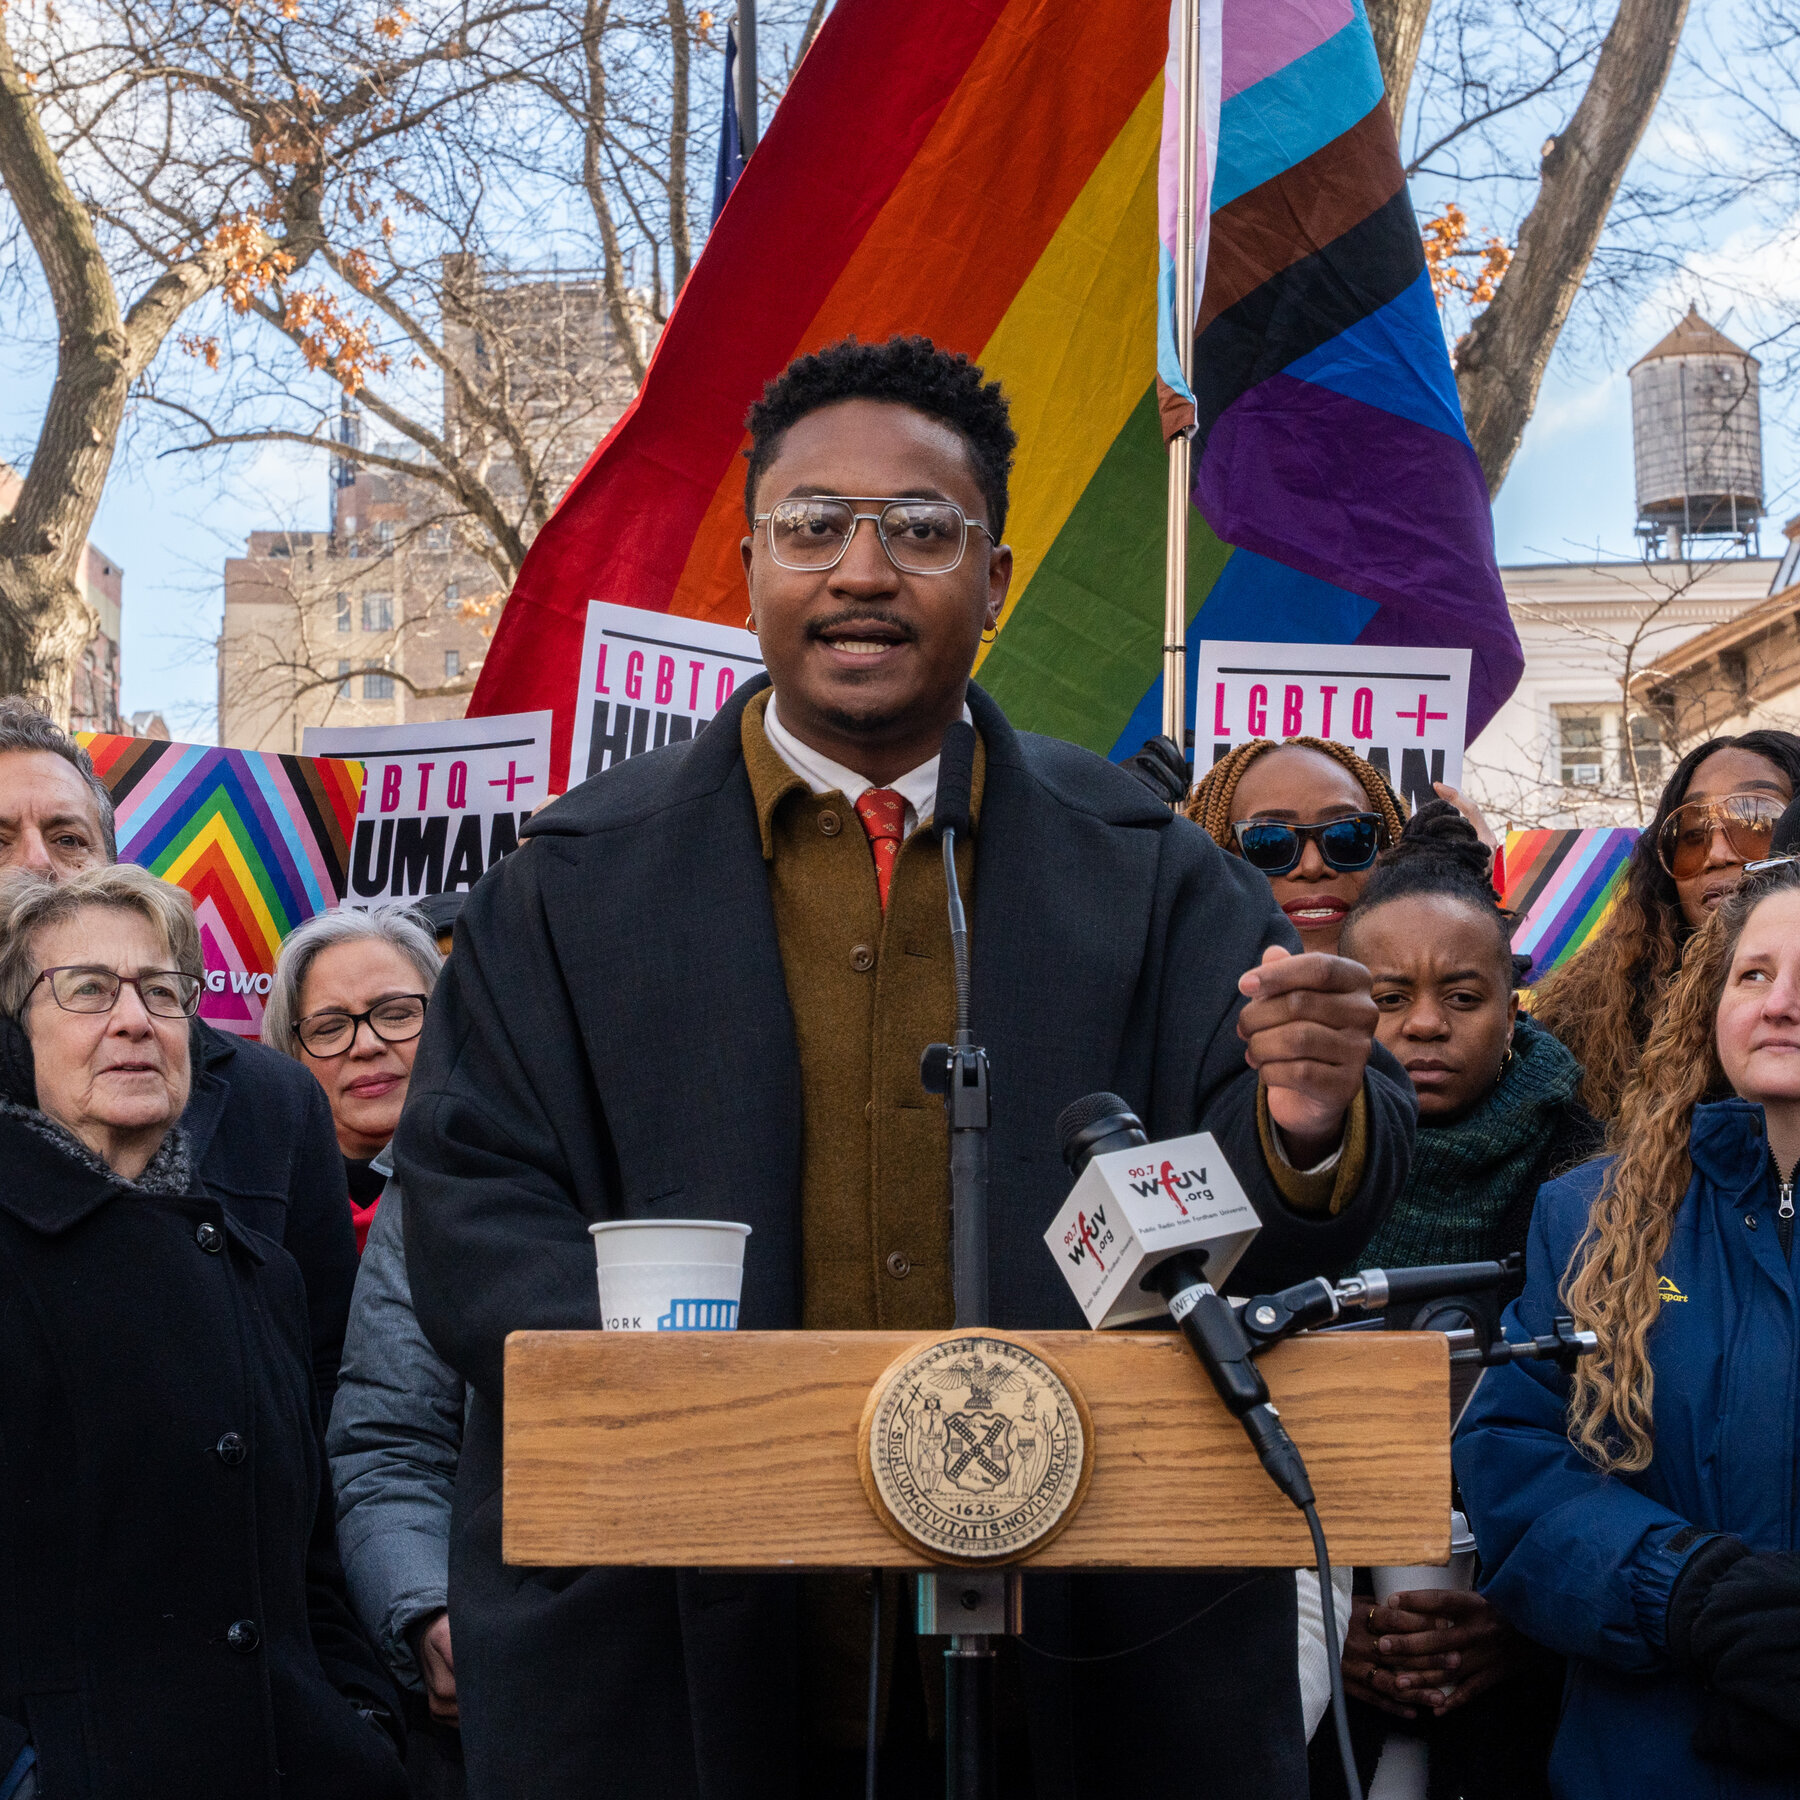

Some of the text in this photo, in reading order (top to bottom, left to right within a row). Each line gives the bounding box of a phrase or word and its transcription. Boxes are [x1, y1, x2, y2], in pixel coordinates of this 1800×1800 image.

[1128, 1164, 1154, 1179] 90.7
[1064, 1222, 1078, 1247] 90.7
[606, 1317, 641, 1329] YORK
[916, 1502, 1001, 1538] CIVITATIS
[1003, 1498, 1041, 1530] NOVI
[1041, 1436, 1067, 1501] EBORACI
[956, 1503, 997, 1517] 1625
